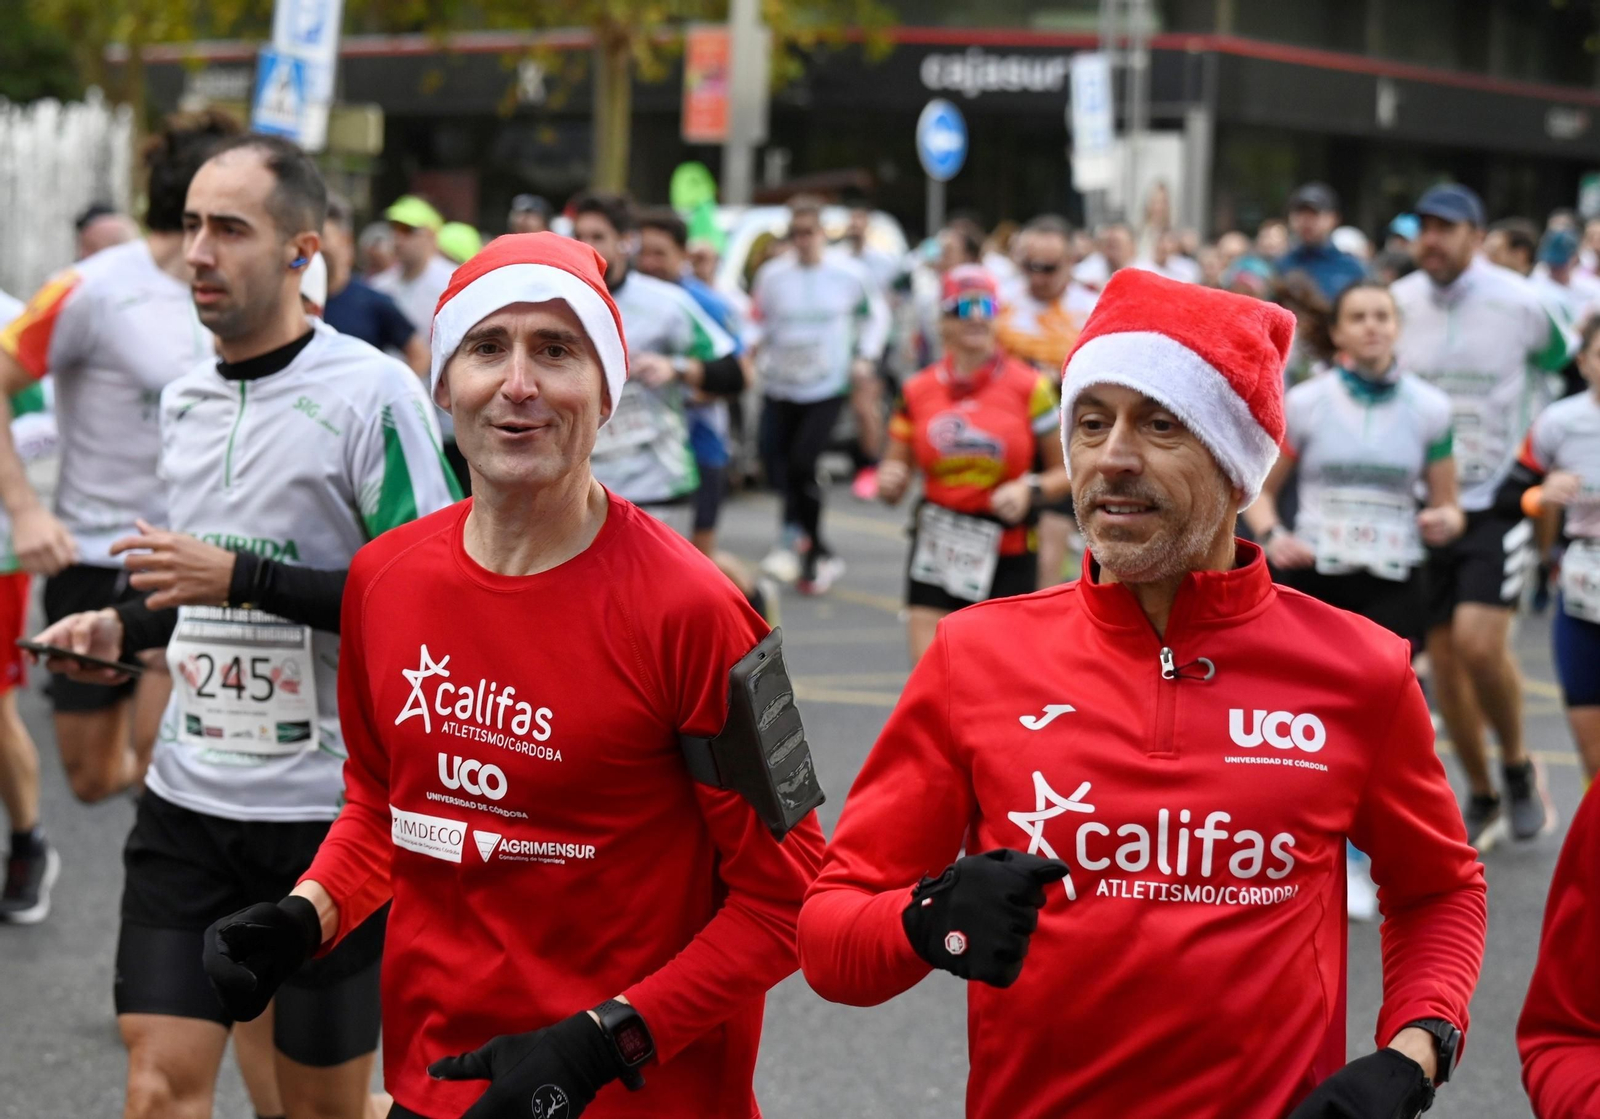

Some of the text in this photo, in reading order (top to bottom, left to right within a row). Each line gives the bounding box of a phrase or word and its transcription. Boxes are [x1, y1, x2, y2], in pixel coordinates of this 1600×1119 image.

[920, 47, 1066, 98] cajasur
[293, 395, 321, 418] SIG
[196, 653, 274, 702] 245
[435, 678, 554, 741] califas
[1229, 708, 1326, 753] UCO
[438, 752, 507, 801] UCO
[1224, 756, 1281, 765] UNIVERSIDAD
[1294, 759, 1328, 772] CÓRDOBA
[426, 792, 477, 809] UNIVERSIDAD
[477, 803, 488, 811] DE
[399, 819, 461, 846] IMDECO
[498, 838, 595, 859] AGRIMENSUR
[1075, 808, 1296, 879] califas
[498, 854, 529, 862] Consulting
